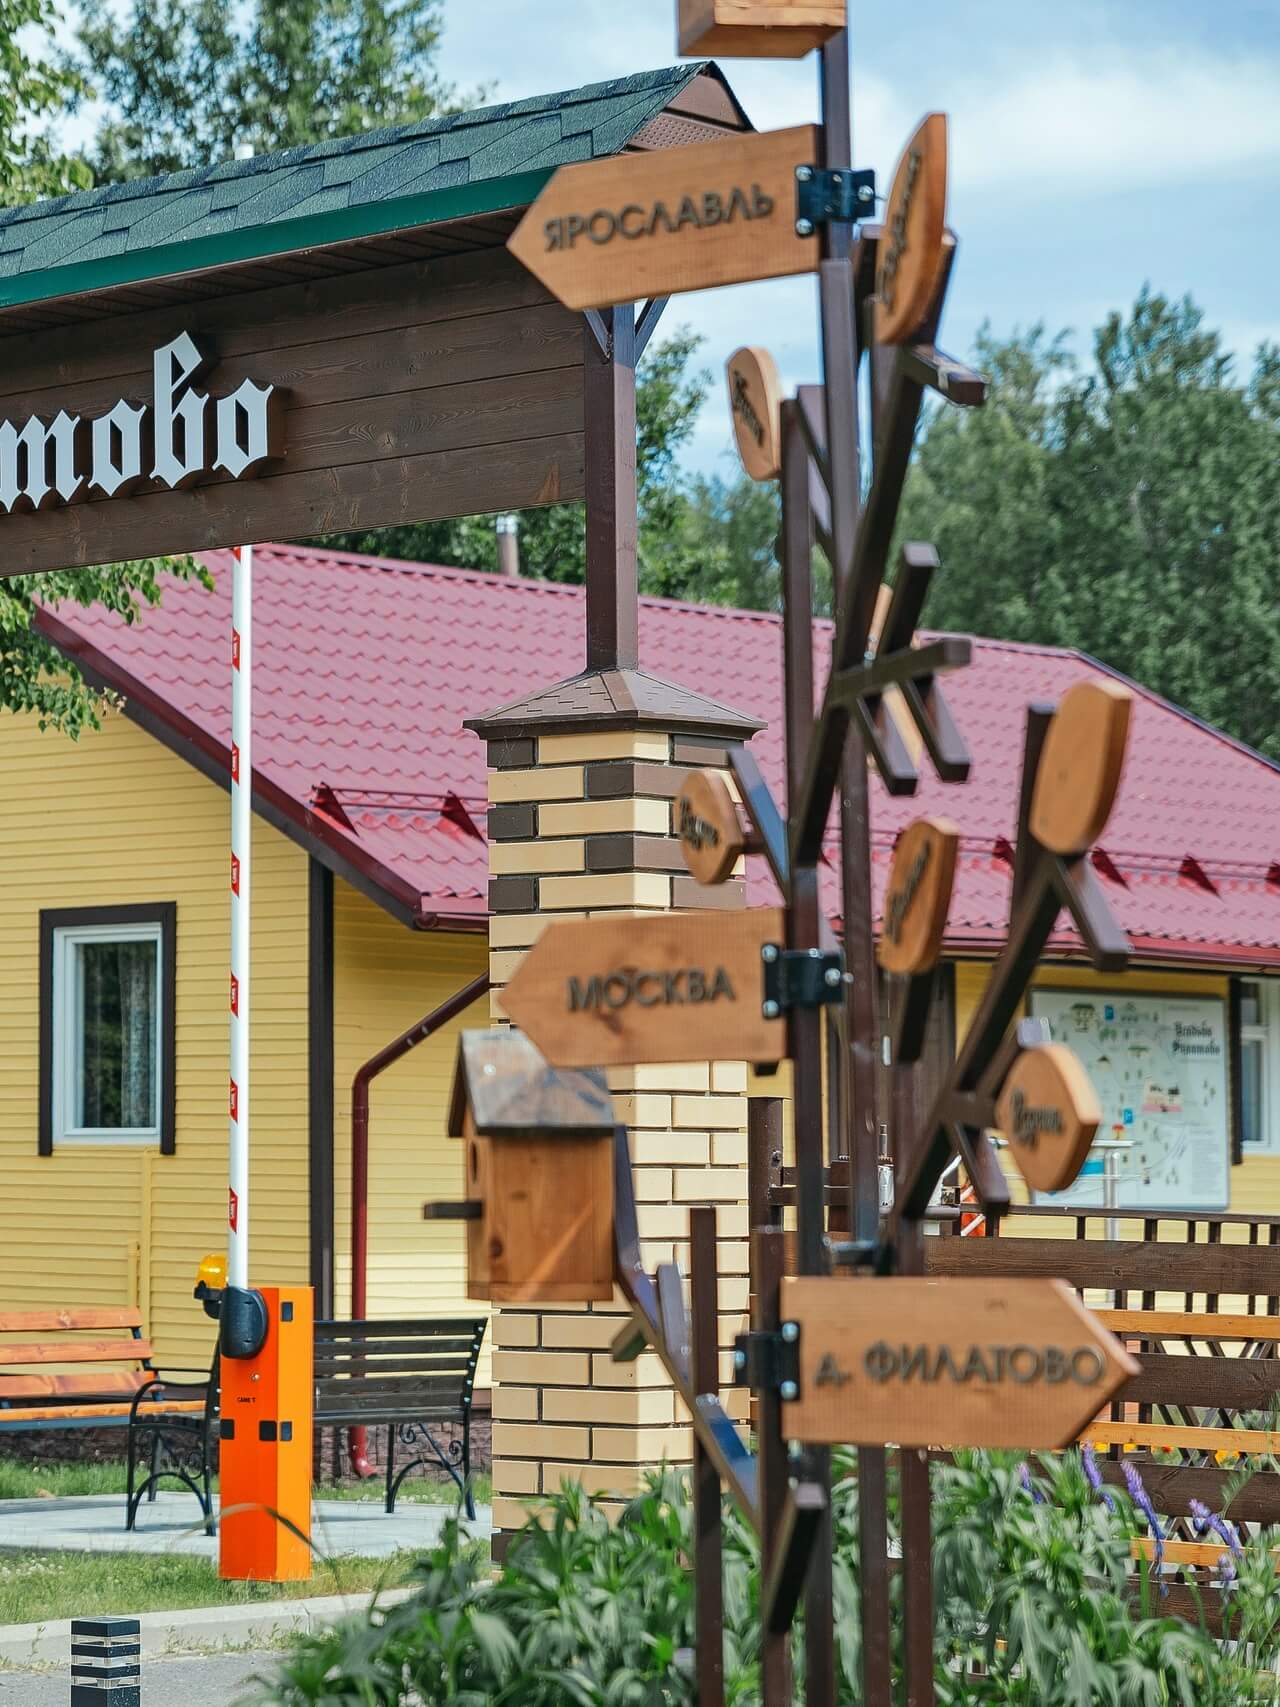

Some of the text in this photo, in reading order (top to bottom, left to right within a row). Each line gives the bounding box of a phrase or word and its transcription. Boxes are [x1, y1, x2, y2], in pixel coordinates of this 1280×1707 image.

[542, 184, 775, 253] ЯРОСЛАВЛЬ
[566, 964, 737, 1013] МОСКВА
[863, 1340, 1107, 1386] ФИЛАТОВО
